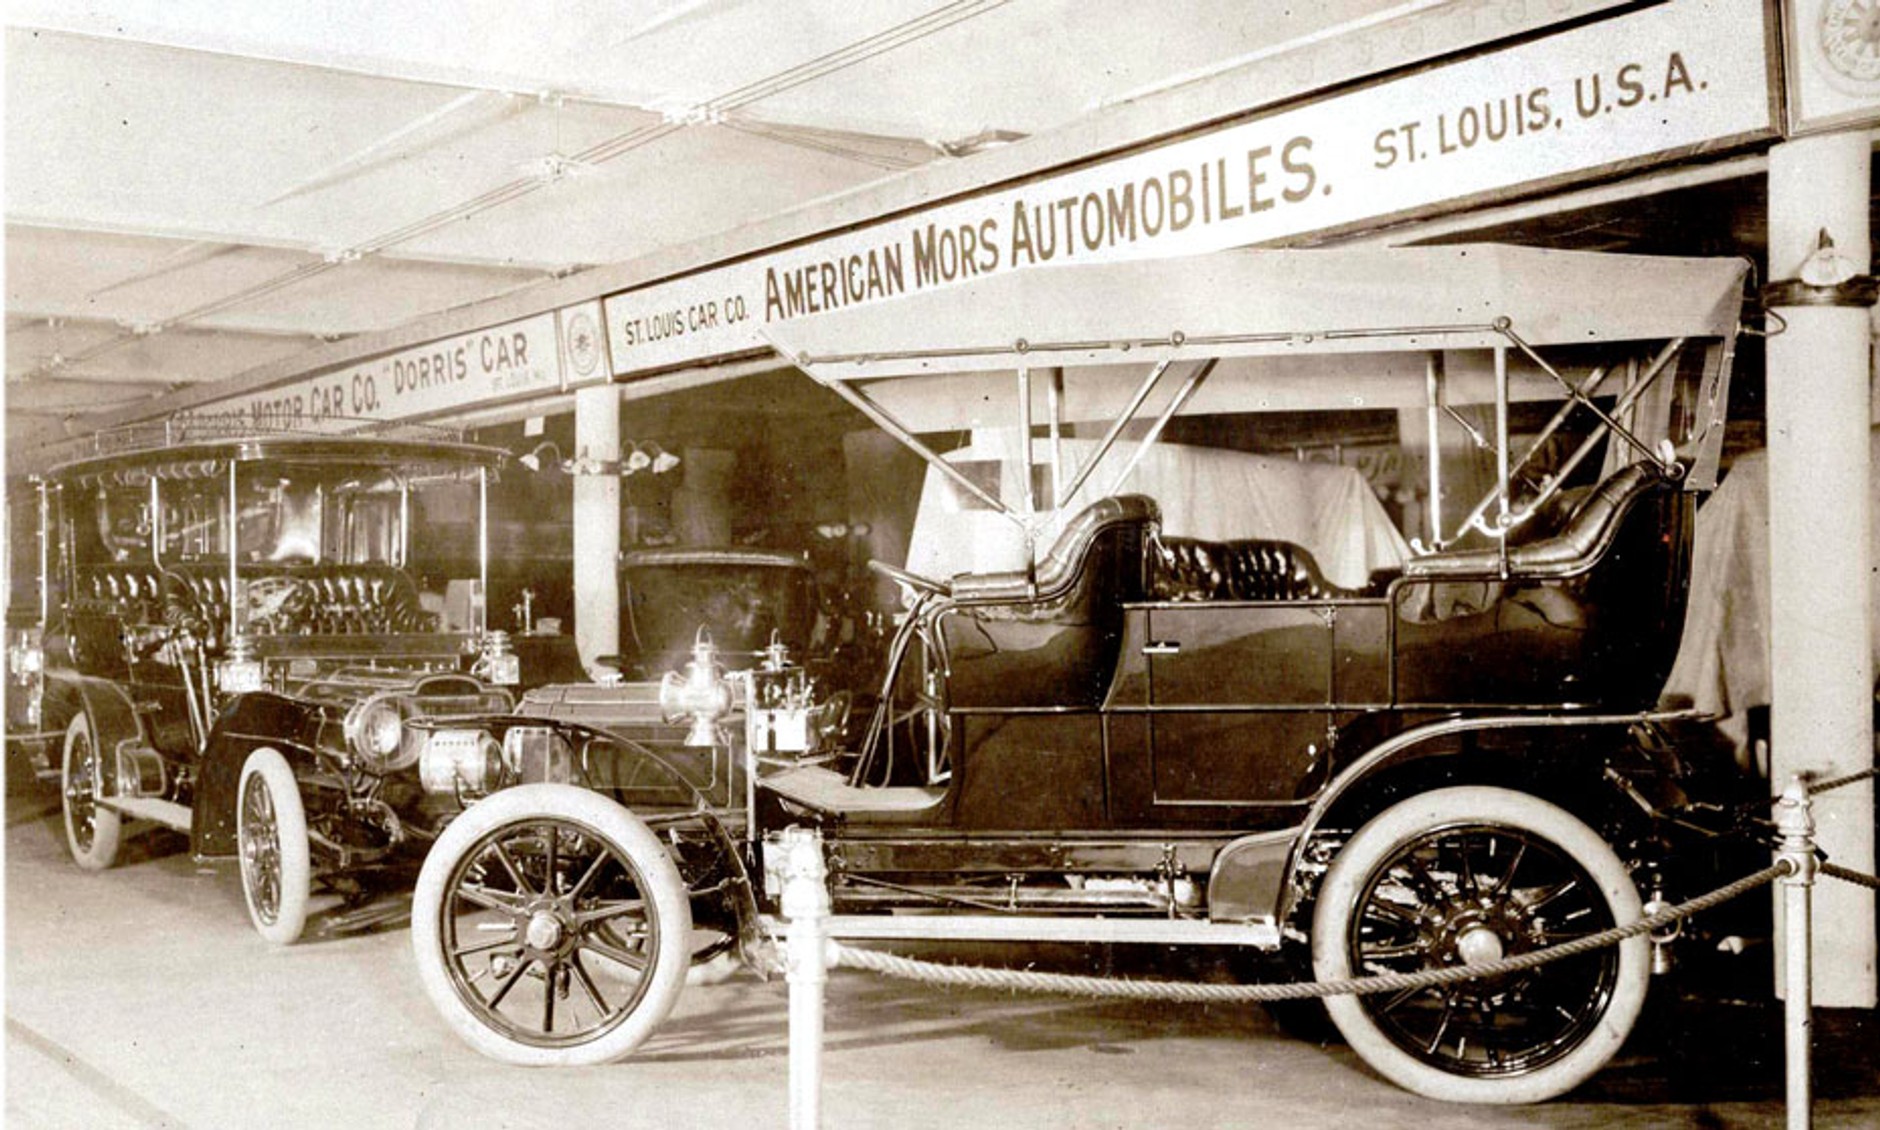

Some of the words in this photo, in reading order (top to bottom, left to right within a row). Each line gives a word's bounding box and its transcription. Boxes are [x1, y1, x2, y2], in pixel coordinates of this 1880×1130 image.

[626, 319, 645, 345] ST.
[646, 309, 685, 342] LOUIS
[688, 301, 718, 332] CAR
[725, 294, 750, 324] CO.
[765, 242, 905, 323] AMERICAN
[912, 218, 1000, 289] MORS
[1010, 135, 1333, 268] AUTOMOBILES.
[1373, 121, 1428, 170] ST.
[1574, 51, 1709, 120] U.S.A.
[251, 395, 303, 432] MOTOR
[310, 384, 344, 423] CAR
[351, 373, 381, 415] CO.
[480, 331, 528, 374] CAR
